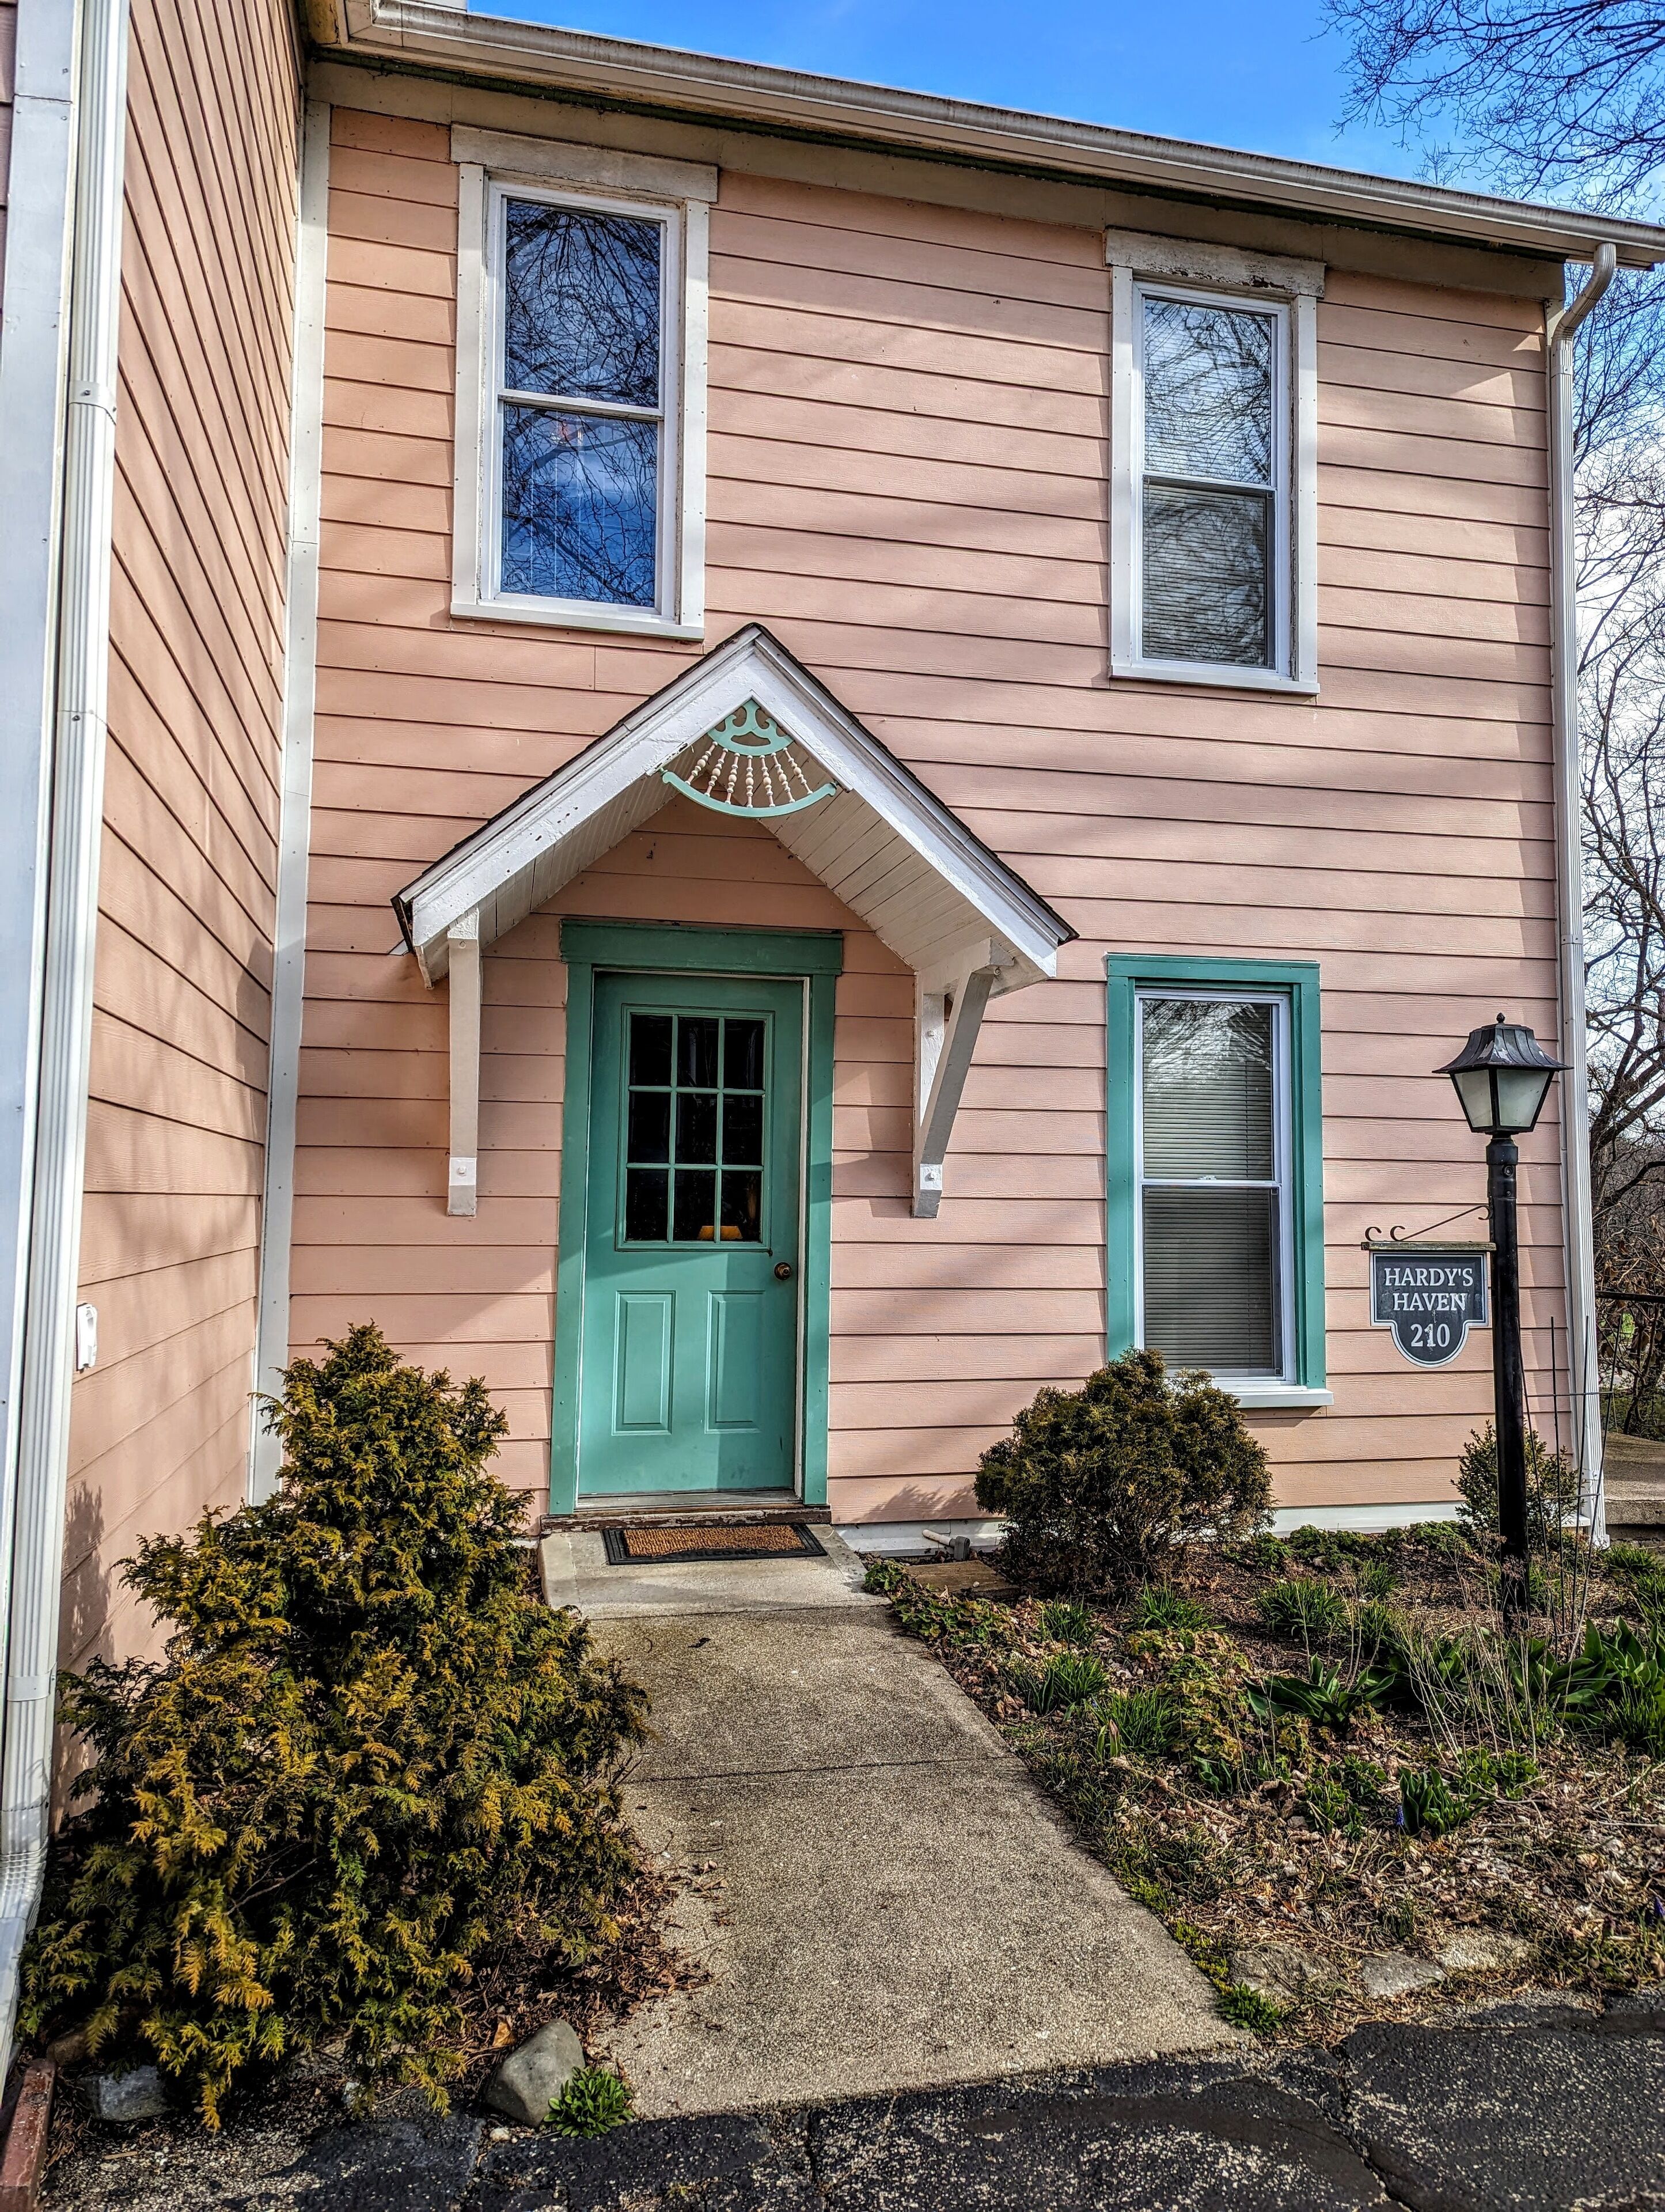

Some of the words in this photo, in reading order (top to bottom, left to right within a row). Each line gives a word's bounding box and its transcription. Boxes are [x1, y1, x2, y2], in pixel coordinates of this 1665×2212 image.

[1384, 1268, 1473, 1286] HARDY'S
[1393, 1293, 1466, 1311] HAVEN
[1410, 1324, 1450, 1347] 210
